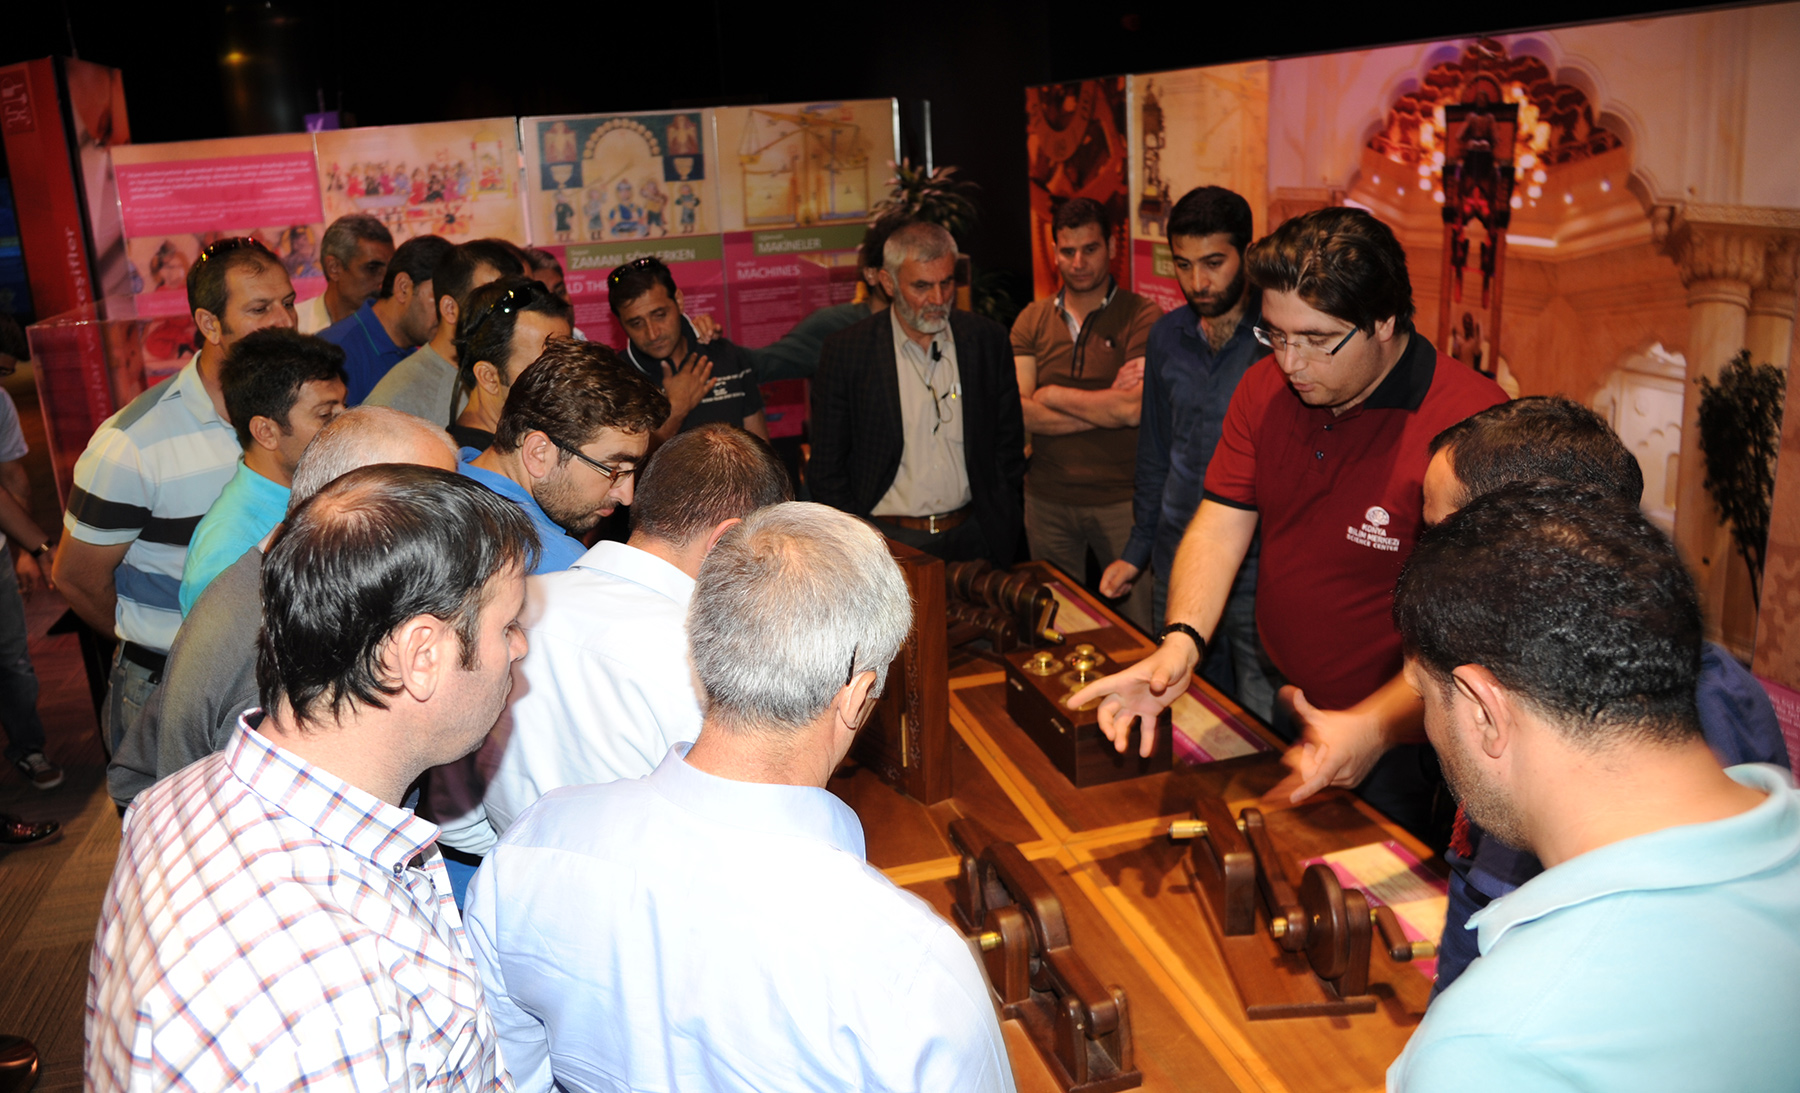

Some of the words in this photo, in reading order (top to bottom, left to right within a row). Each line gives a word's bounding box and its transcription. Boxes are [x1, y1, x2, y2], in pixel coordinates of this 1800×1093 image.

[572, 254, 623, 270] ZAMANI
[737, 265, 800, 279] MACHINES
[1361, 523, 1387, 537] KONYA
[1372, 542, 1399, 552] CENTER
